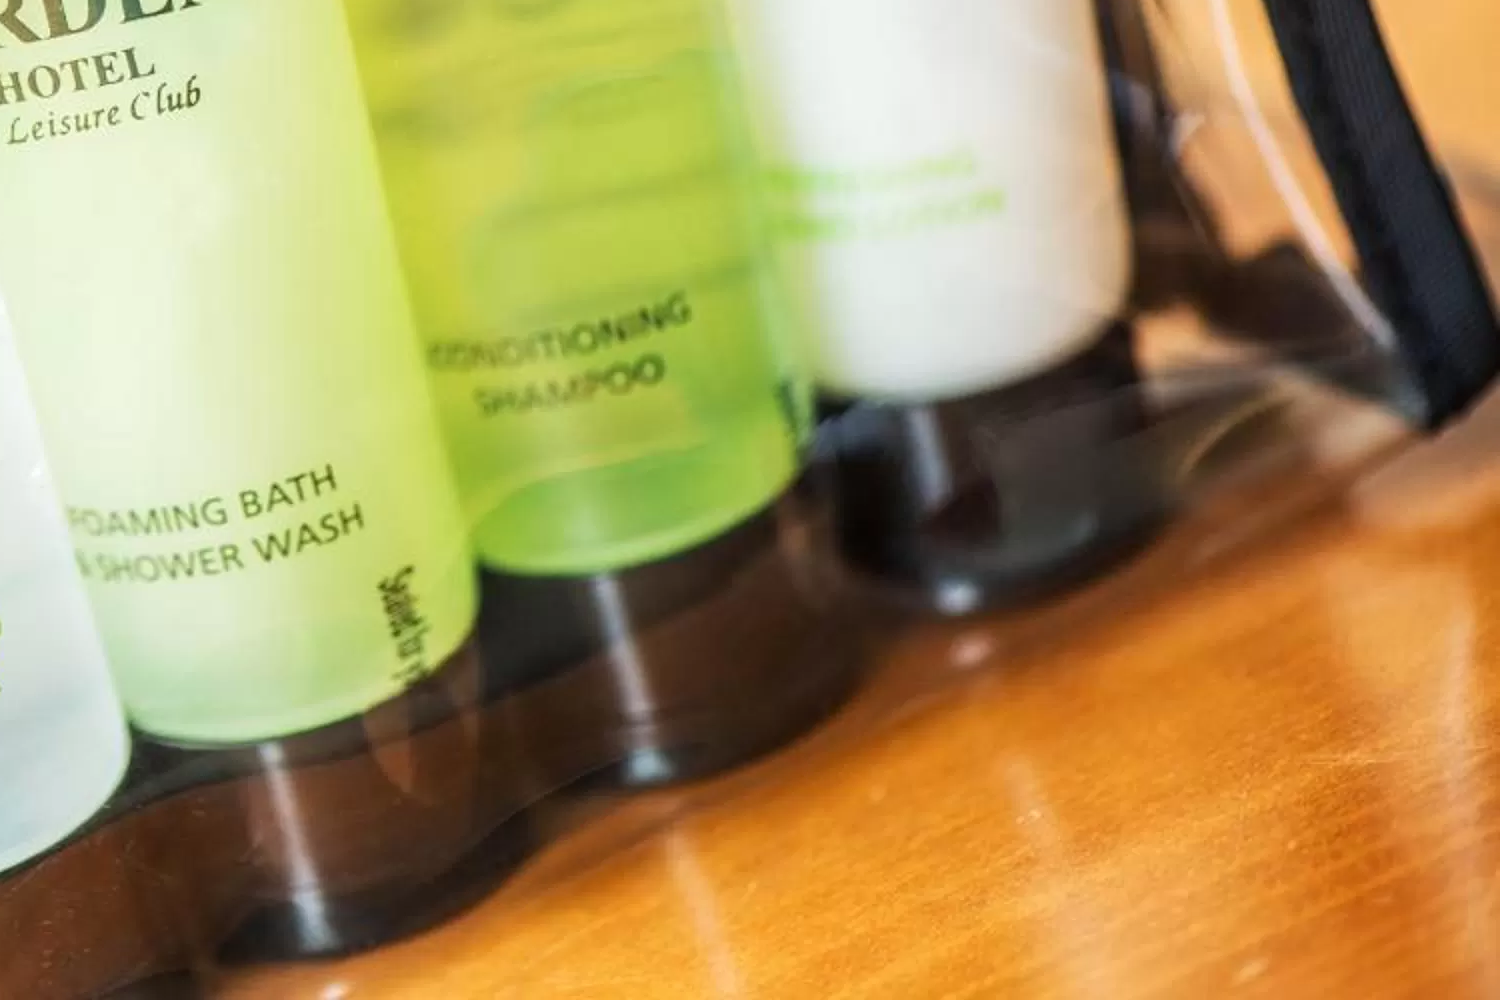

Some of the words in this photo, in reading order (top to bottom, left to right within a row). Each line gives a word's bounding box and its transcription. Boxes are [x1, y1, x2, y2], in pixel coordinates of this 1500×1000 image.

[6, 101, 121, 145] Leisure
[130, 73, 202, 121] Club
[239, 463, 339, 519] BATH
[96, 543, 245, 585] SHOWER
[251, 503, 366, 563] WASH
